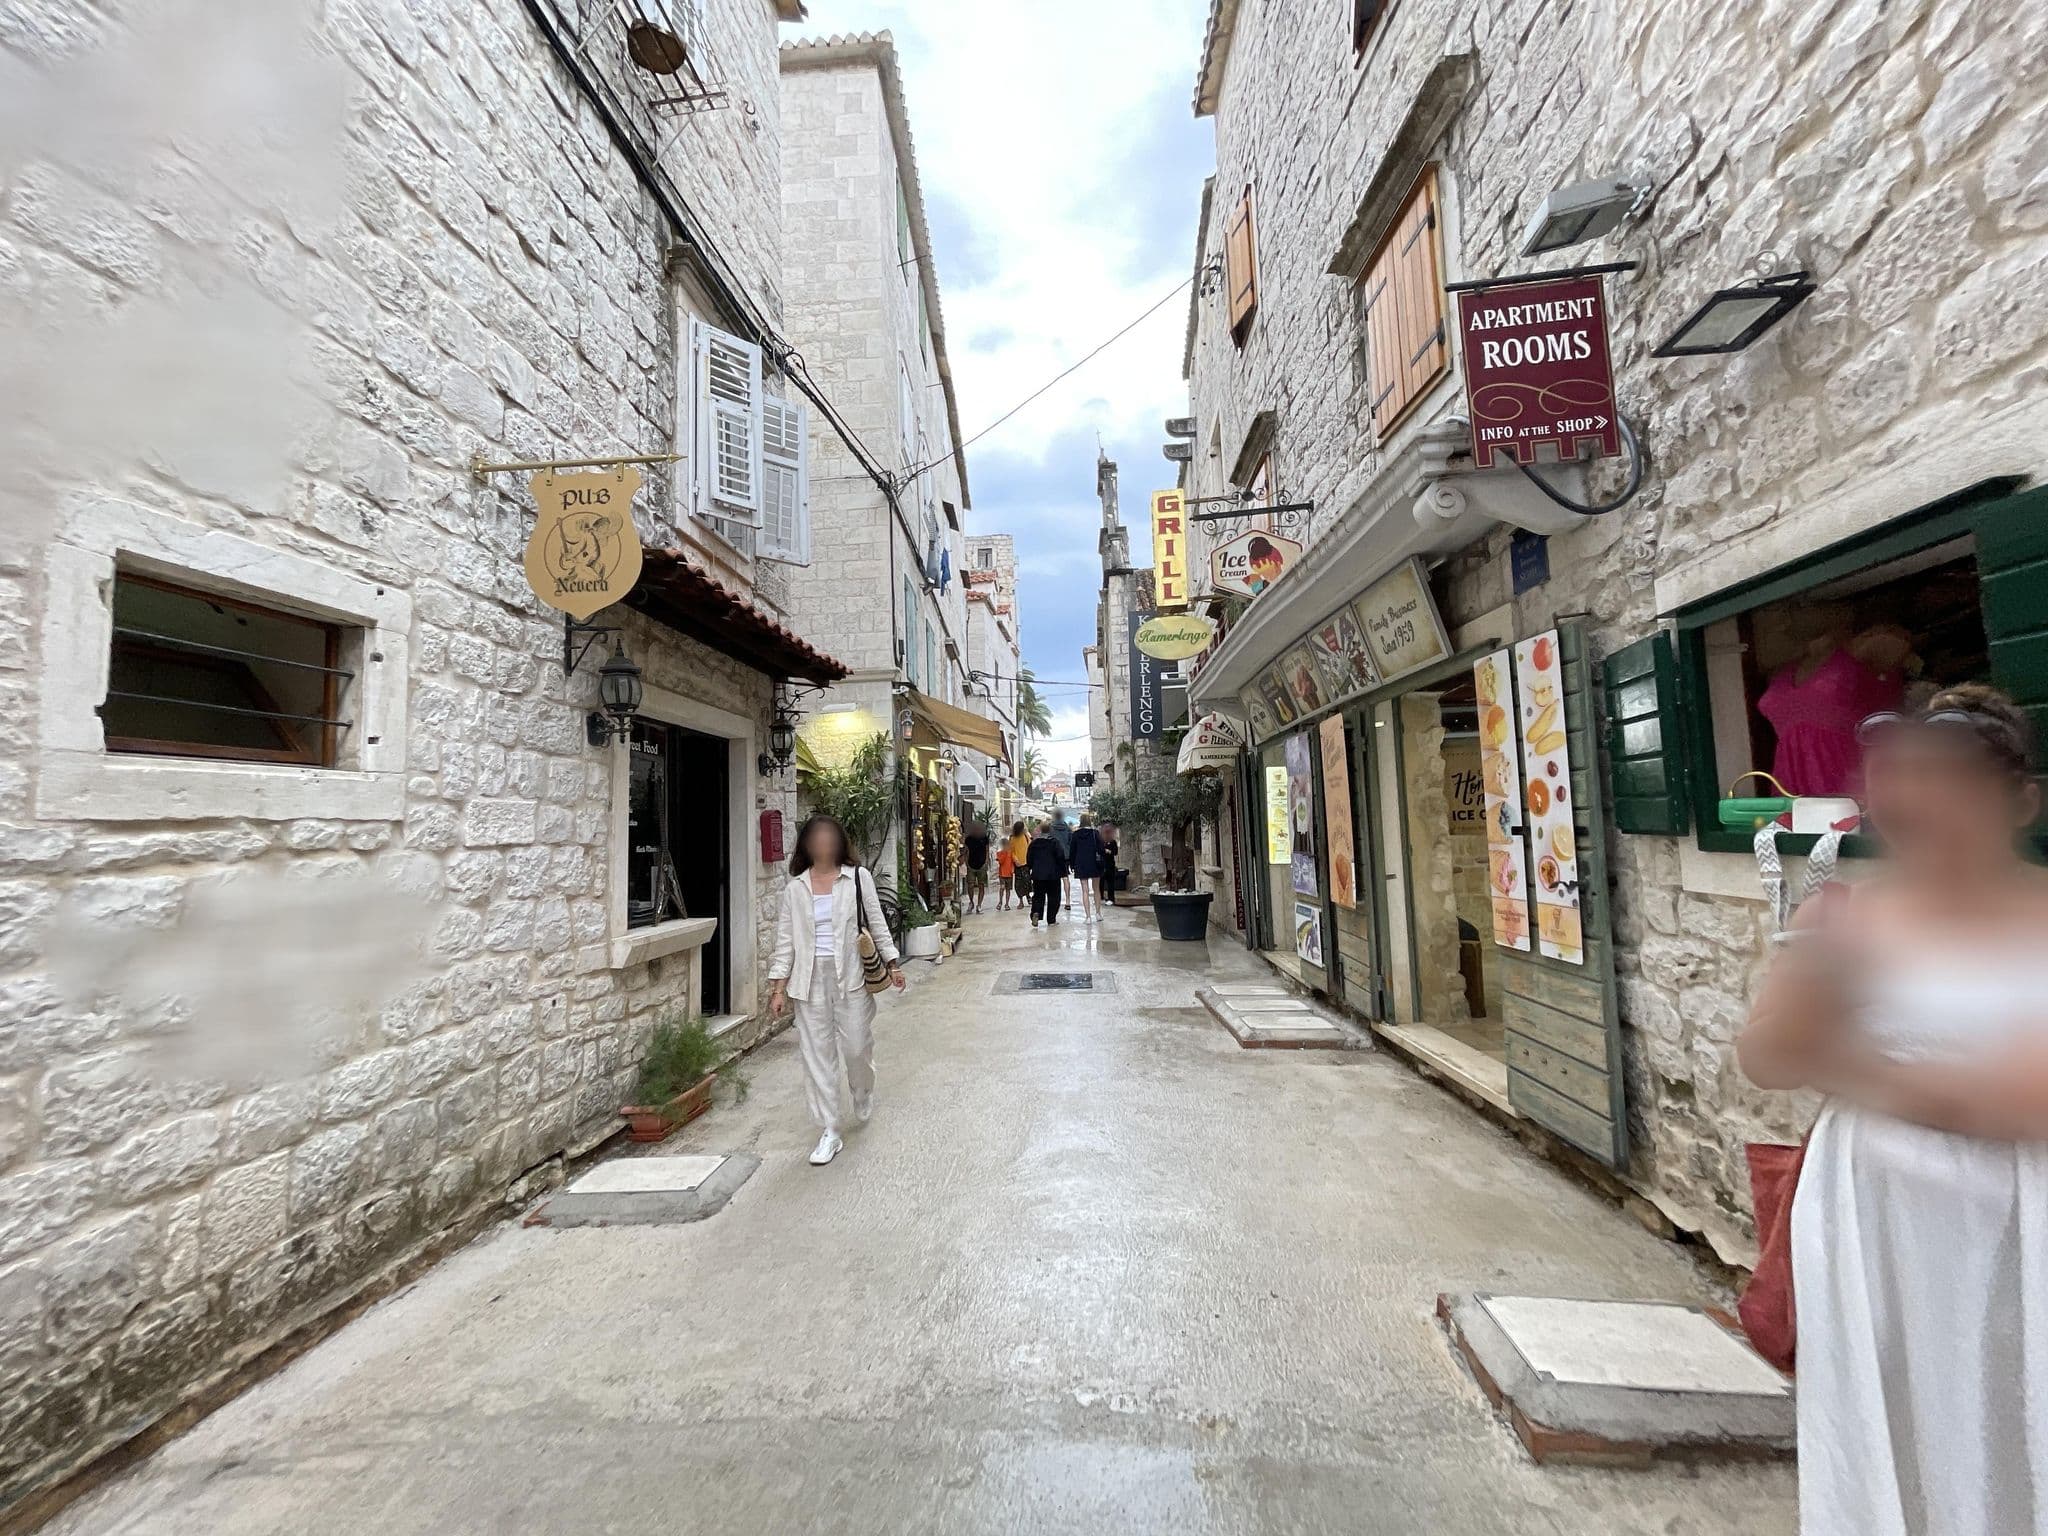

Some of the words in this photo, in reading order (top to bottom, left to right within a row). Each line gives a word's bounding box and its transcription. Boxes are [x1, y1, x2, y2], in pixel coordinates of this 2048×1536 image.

[1470, 297, 1595, 331] APARTMENT
[1482, 330, 1591, 369] ROOMS
[1481, 425, 1513, 441] INFO
[1518, 428, 1529, 437] AT
[1533, 426, 1550, 436] THE
[1557, 417, 1593, 433] SHOP
[559, 488, 611, 510] PUB
[1157, 496, 1182, 600] GRILL
[1219, 552, 1247, 568] Ice
[1219, 569, 1247, 578] Cream
[1138, 628, 1209, 644] Kamerlengo
[1394, 620, 1414, 648] 1959
[1137, 615, 1154, 734] KERLENGO
[643, 741, 659, 755] Food
[1452, 810, 1475, 821] ICE
